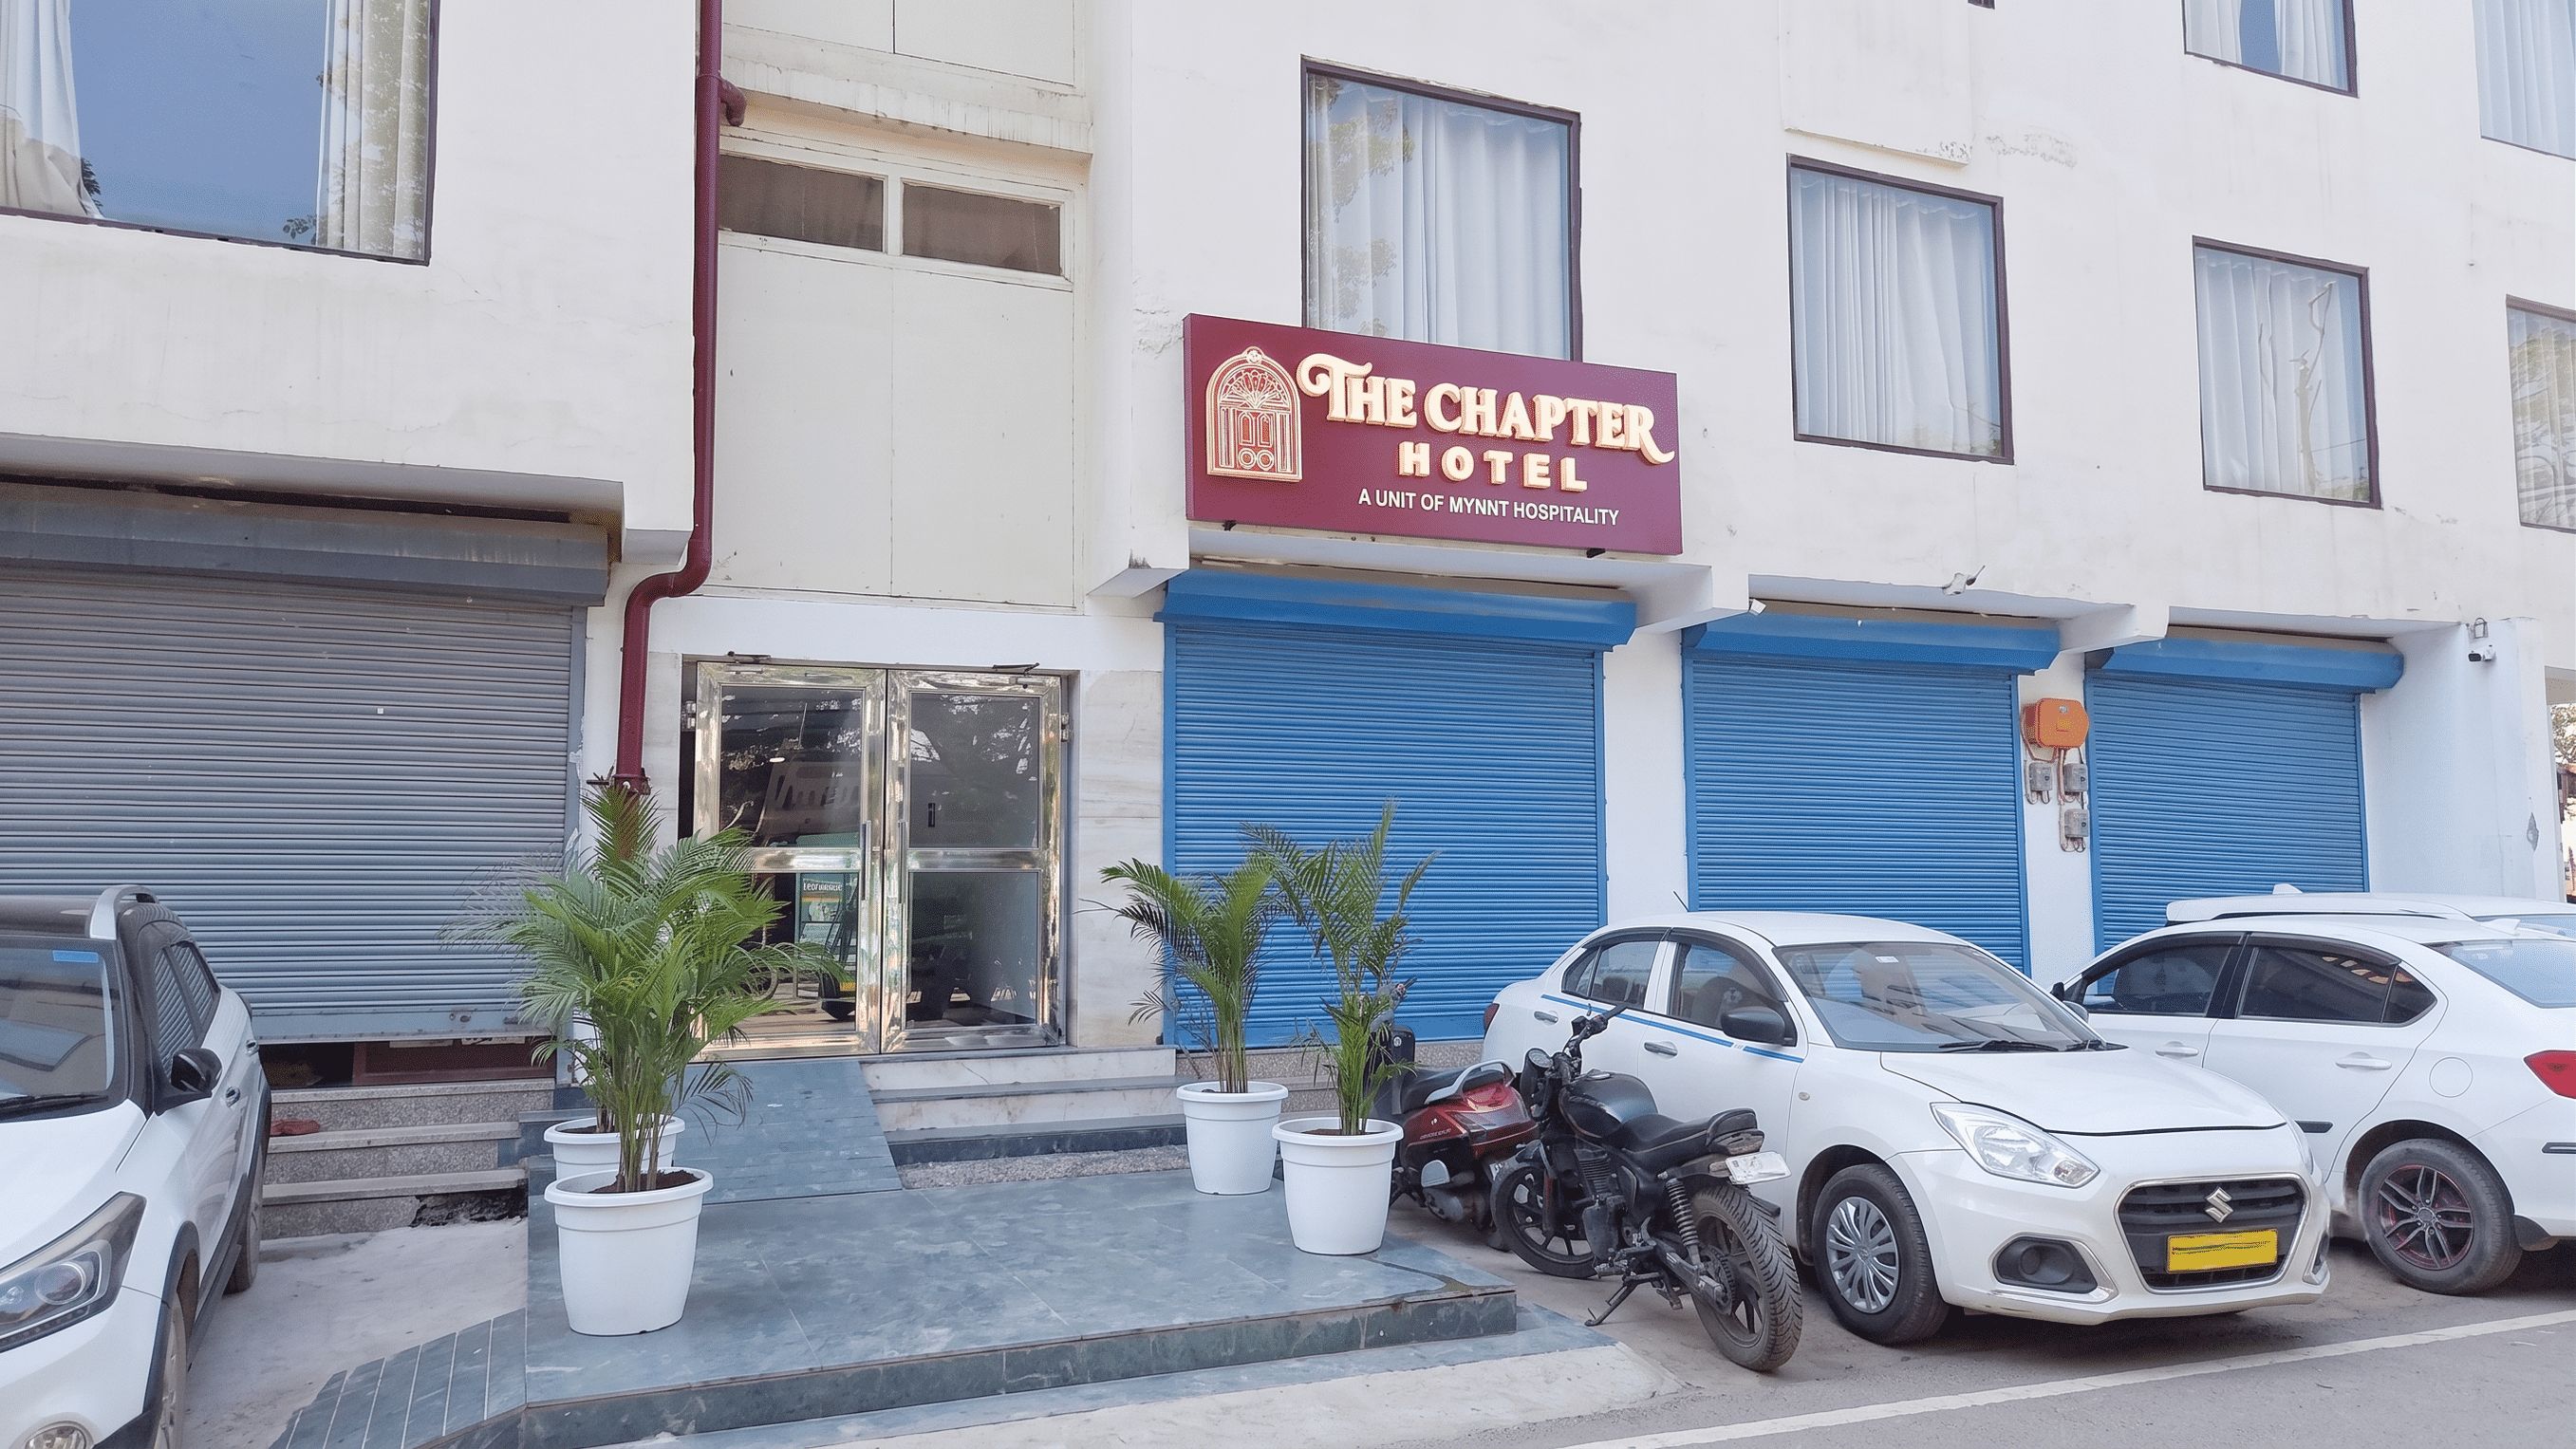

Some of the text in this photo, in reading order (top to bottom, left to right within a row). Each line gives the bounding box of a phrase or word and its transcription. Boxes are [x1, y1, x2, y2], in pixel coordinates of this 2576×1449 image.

[1296, 352, 1675, 465] THE CHAPTER
[1398, 441, 1588, 492] HOTEL
[1358, 488, 1619, 526] A UNIT OF MYNNT HOSPITALITY
